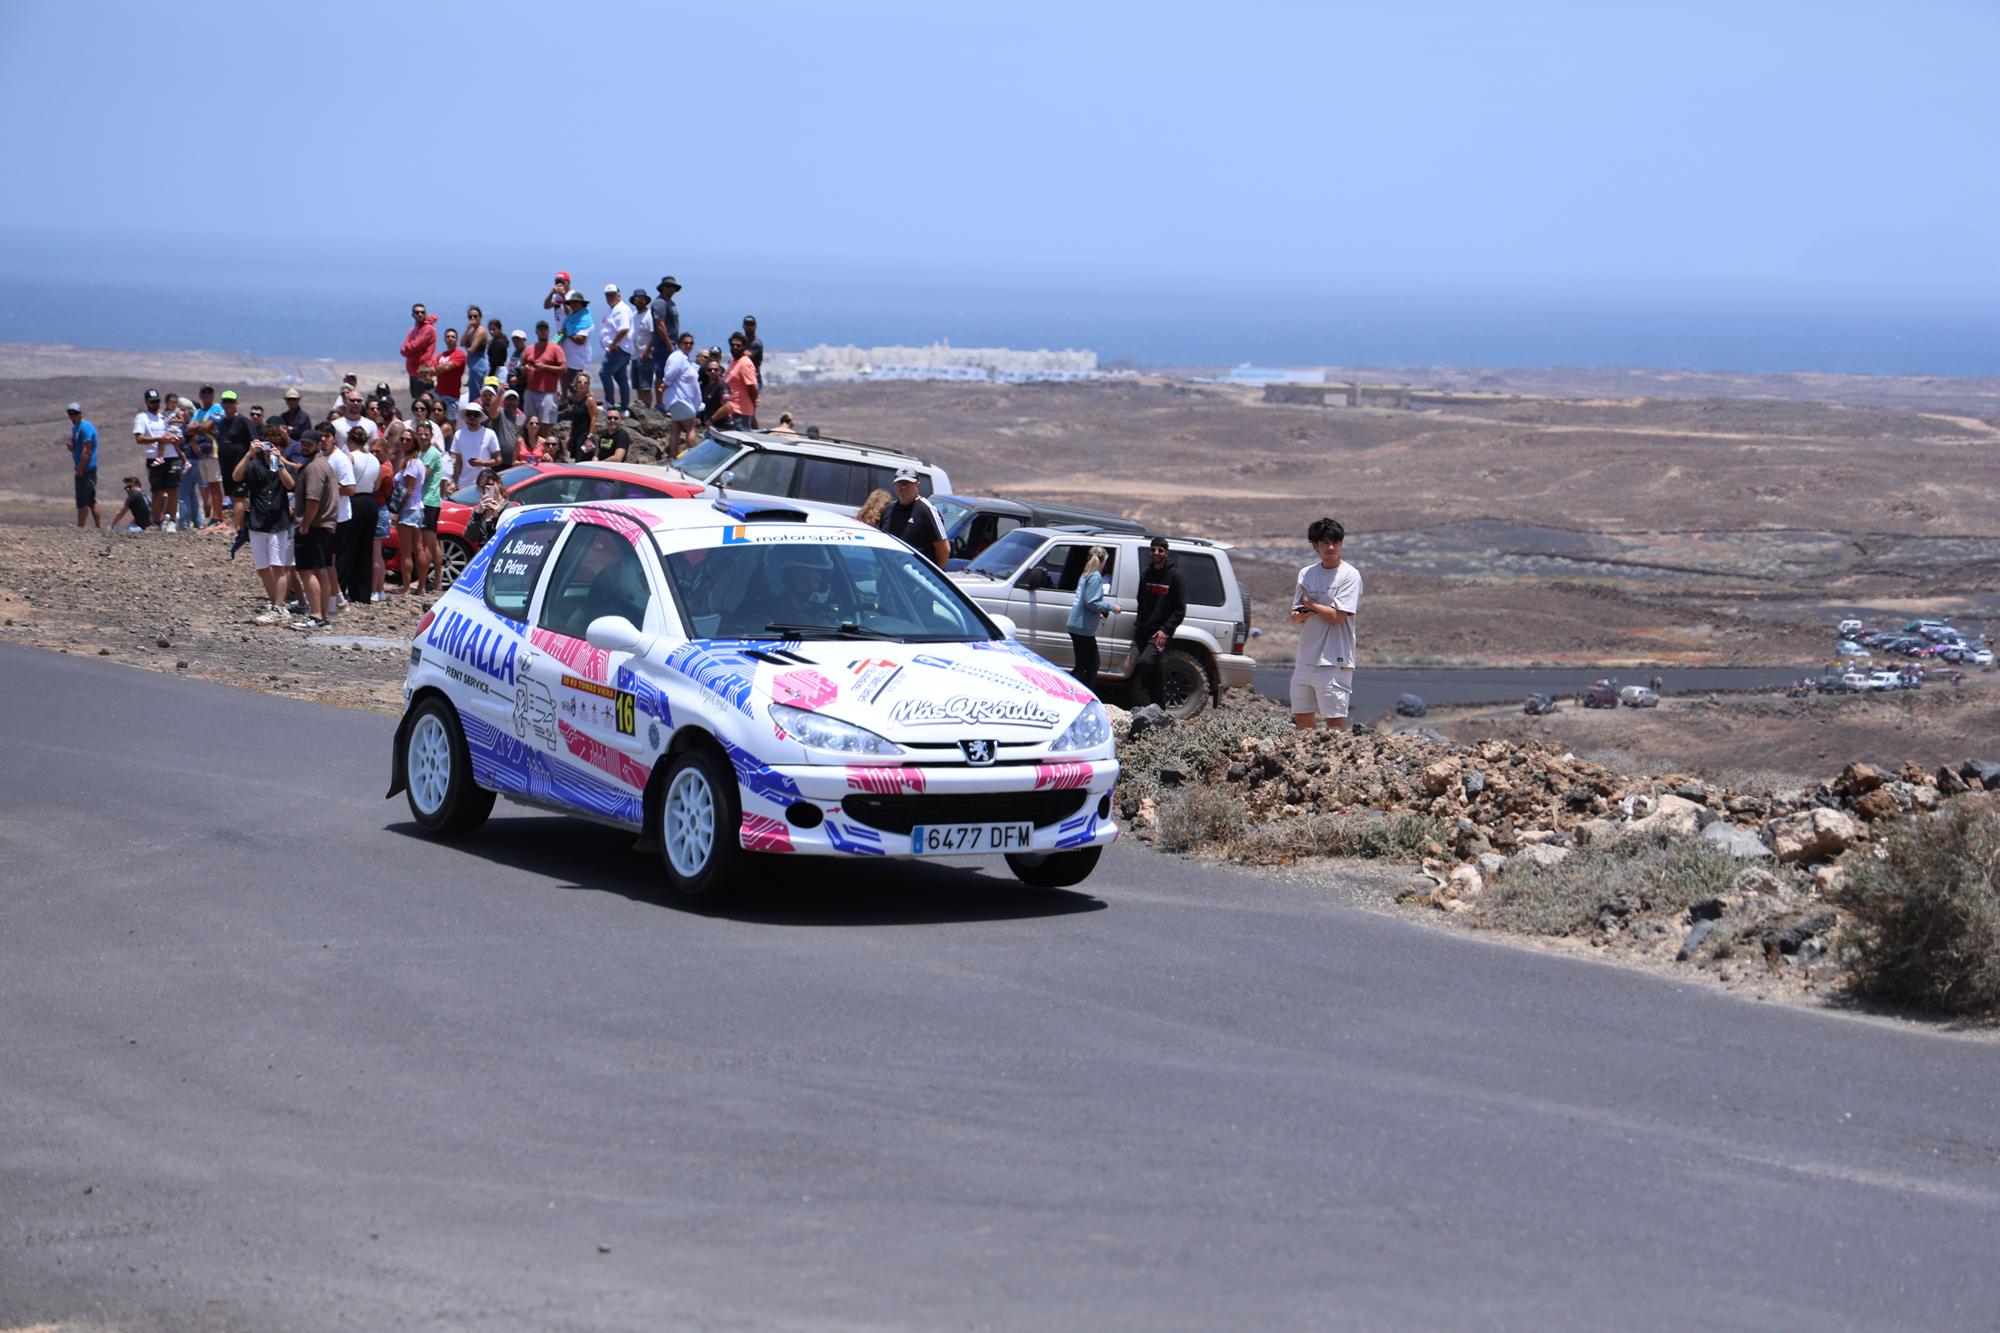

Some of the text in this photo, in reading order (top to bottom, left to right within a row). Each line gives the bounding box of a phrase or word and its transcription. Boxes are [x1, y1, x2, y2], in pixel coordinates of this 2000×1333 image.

[502, 540, 544, 557] A. Barrios
[755, 534, 854, 543] motorsport
[493, 558, 528, 575] B. Pérez
[427, 606, 518, 687] LIMALLA
[445, 666, 489, 694] RENT SERVICE
[616, 692, 633, 734] 16
[928, 825, 1030, 850] 6477 DFM
